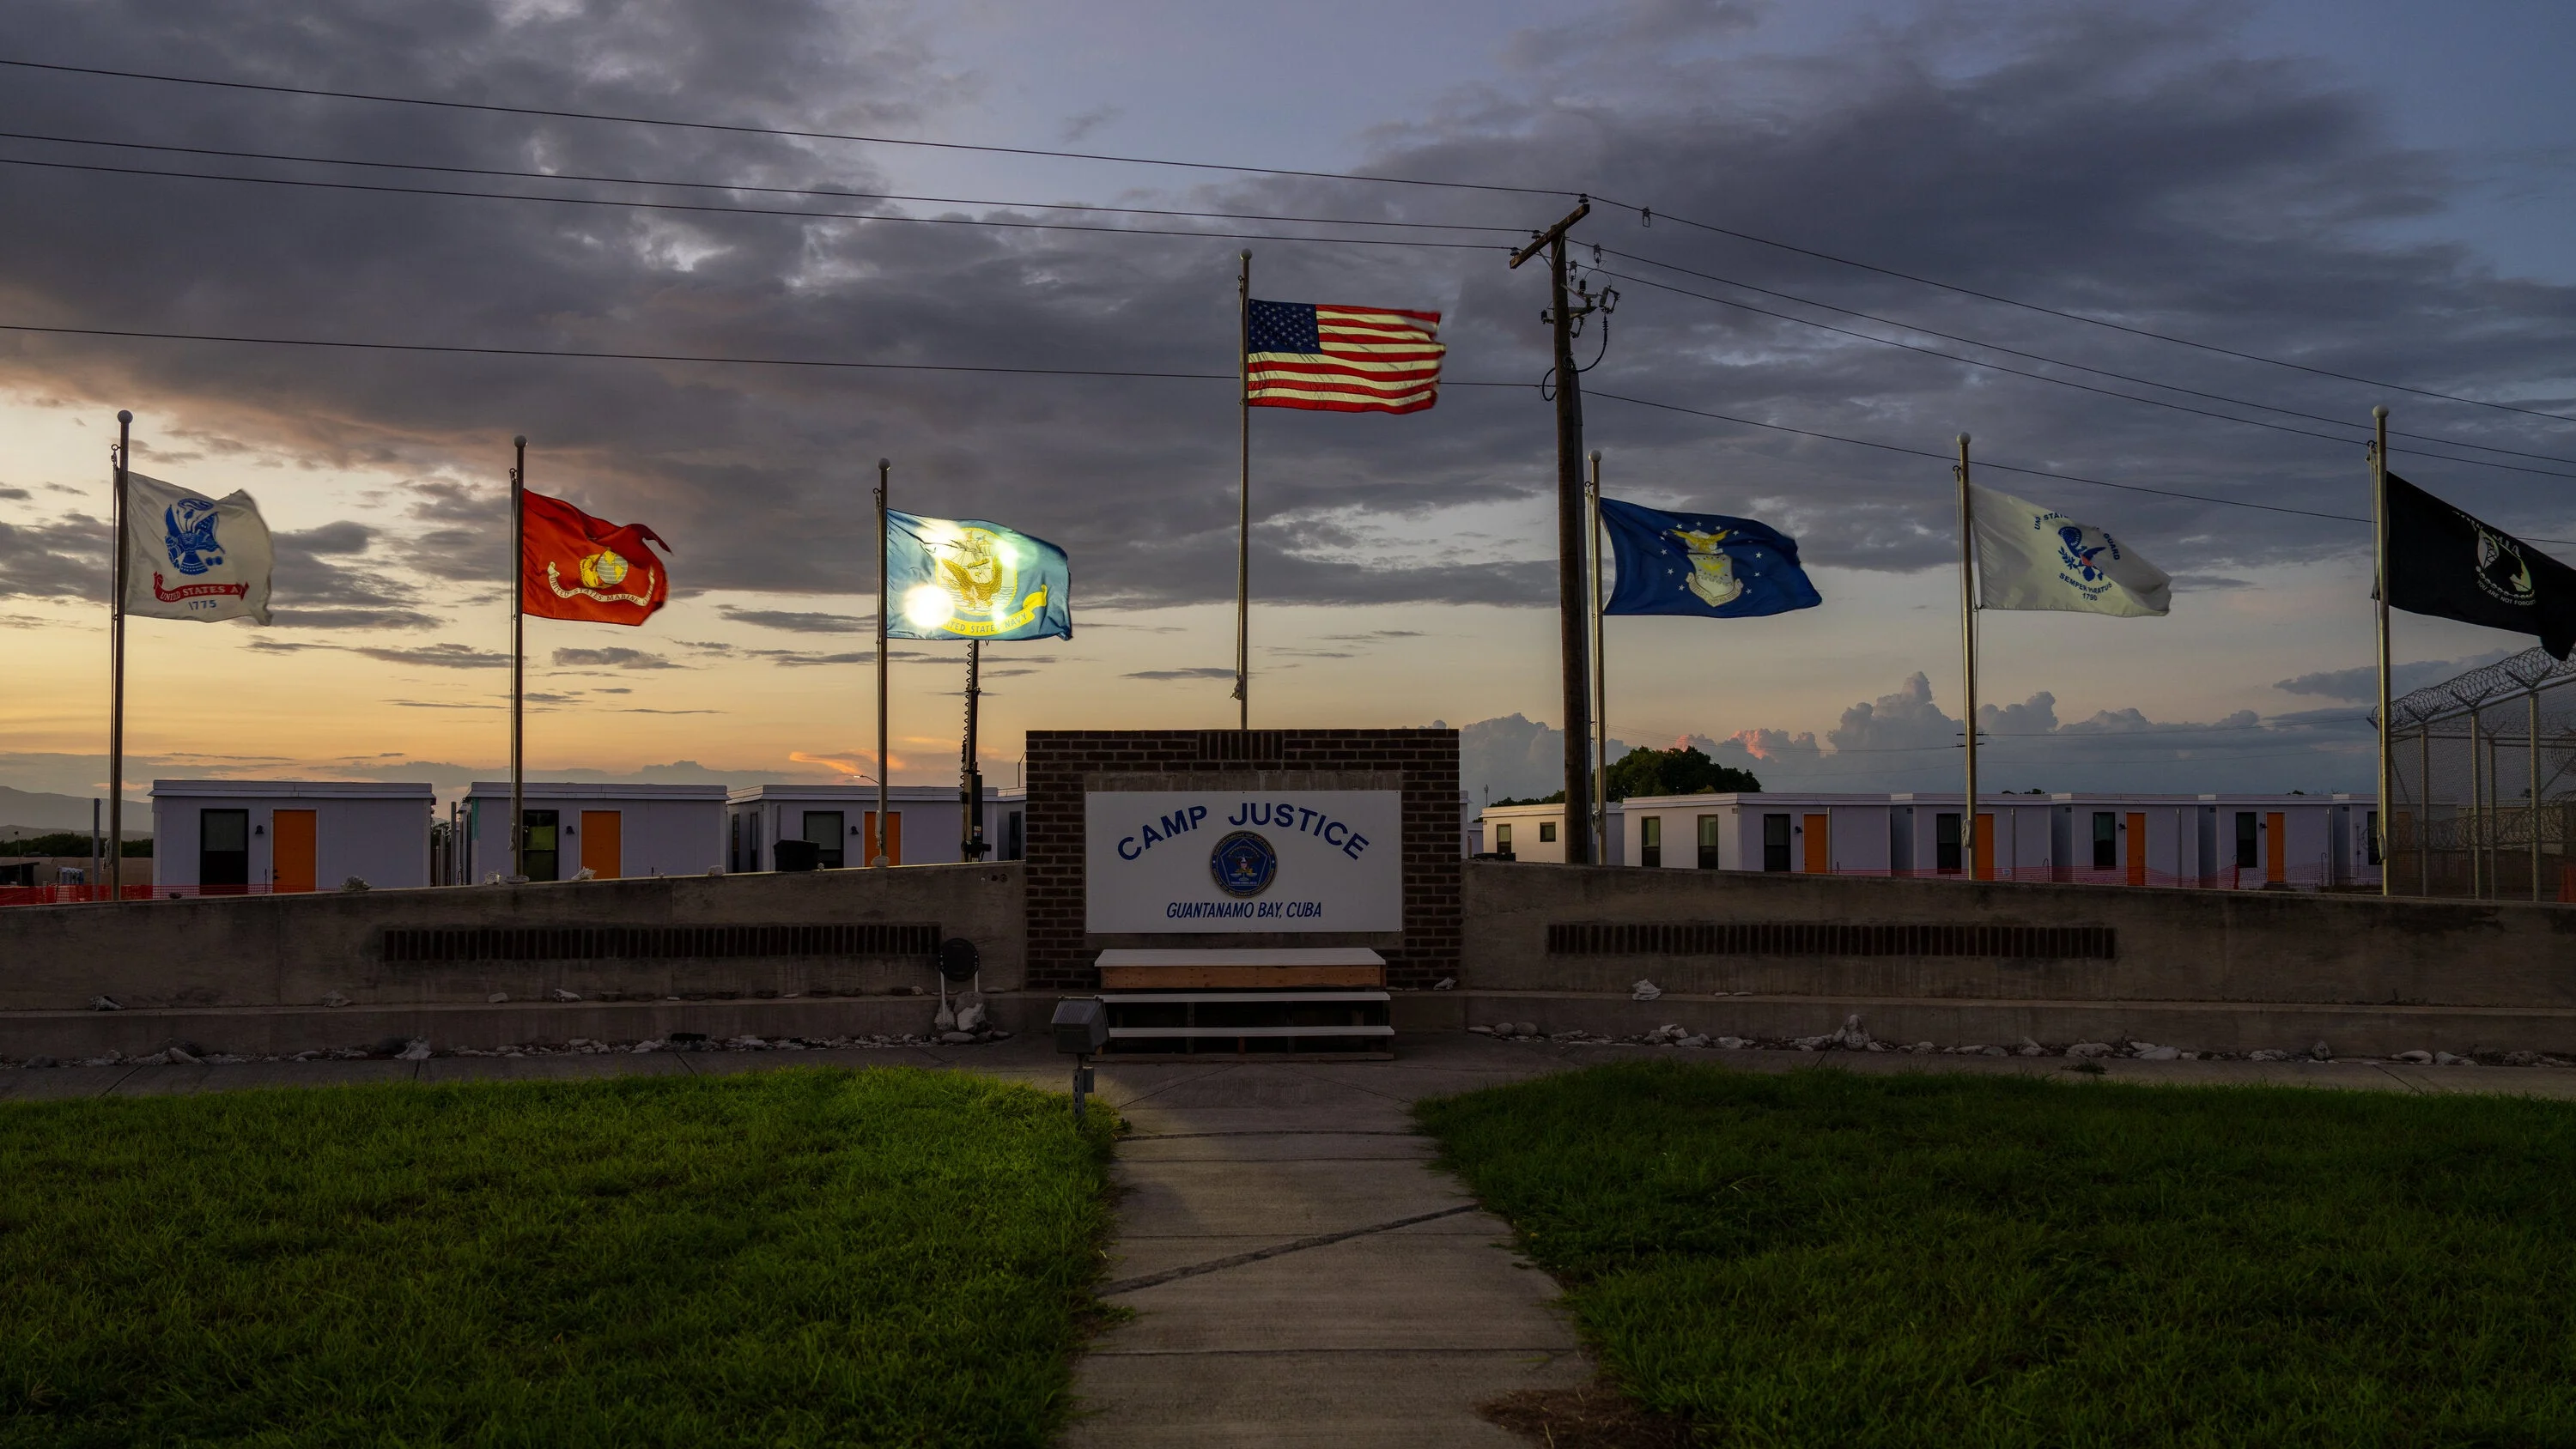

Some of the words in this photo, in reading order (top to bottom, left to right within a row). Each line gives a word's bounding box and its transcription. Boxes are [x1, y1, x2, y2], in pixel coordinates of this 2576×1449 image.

[2103, 533, 2120, 561] GUARD
[182, 585, 224, 596] STATES
[2059, 573, 2087, 591] SEMPER
[574, 588, 603, 601] STATES
[606, 594, 640, 603] MARINE
[2082, 592, 2098, 601] 1790
[188, 600, 216, 610] 1775
[946, 621, 966, 631] ITED
[1005, 613, 1027, 628] NAVY
[1118, 805, 1207, 861] CAMP
[1228, 803, 1370, 860] JUSTICE
[1166, 901, 1254, 919] GUANTANAMO
[1257, 902, 1283, 919] BAY,
[1286, 902, 1321, 918] CUBA
